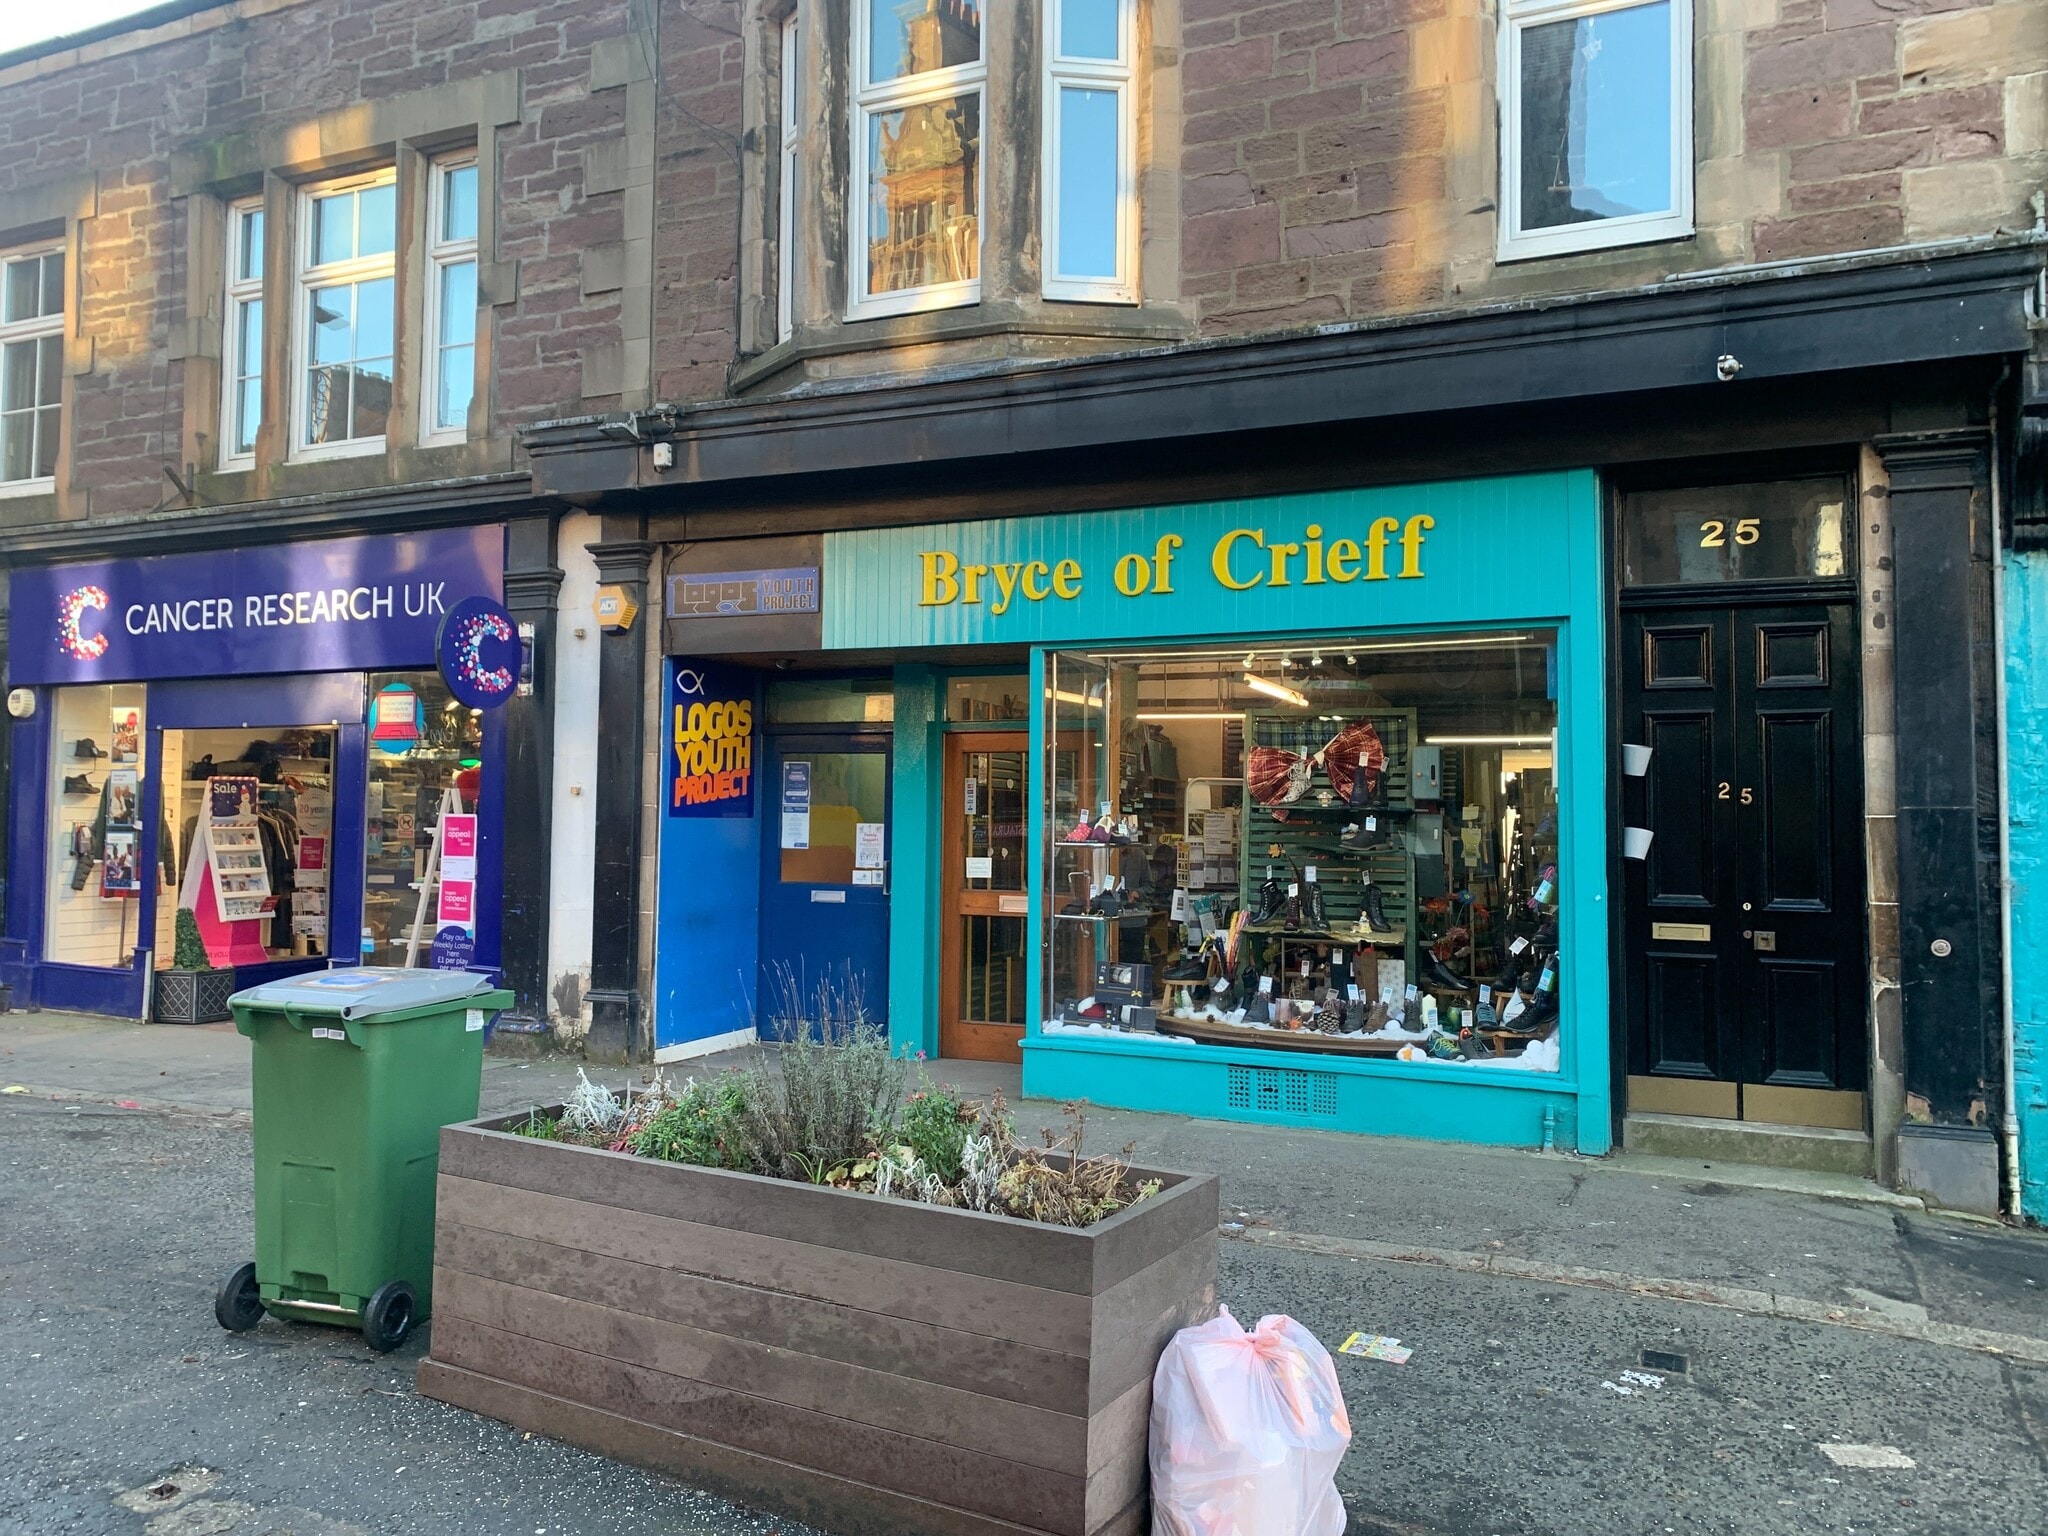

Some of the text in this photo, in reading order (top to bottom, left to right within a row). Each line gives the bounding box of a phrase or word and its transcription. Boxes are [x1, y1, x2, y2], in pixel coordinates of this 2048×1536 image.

[1700, 518, 1760, 547] 25
[919, 514, 1435, 615] Bryce of Crieff
[762, 577, 814, 594] YOUTH
[125, 581, 445, 635] CANCER RESEARCH UK
[600, 599, 617, 611] ADT
[762, 594, 814, 611] PROJECT
[674, 699, 752, 743] LOGOS
[674, 735, 751, 778] YOUTH
[213, 782, 238, 794] Sale
[674, 768, 751, 808] PROJECT
[1718, 782, 1752, 805] 25
[299, 804, 309, 814] 20
[447, 830, 471, 839] appeal
[444, 895, 468, 903] appeal
[442, 932, 454, 942] Play
[433, 940, 474, 951] Weekly Lottery
[446, 949, 460, 957] here
[437, 955, 444, 963] £1
[456, 957, 469, 966] play
